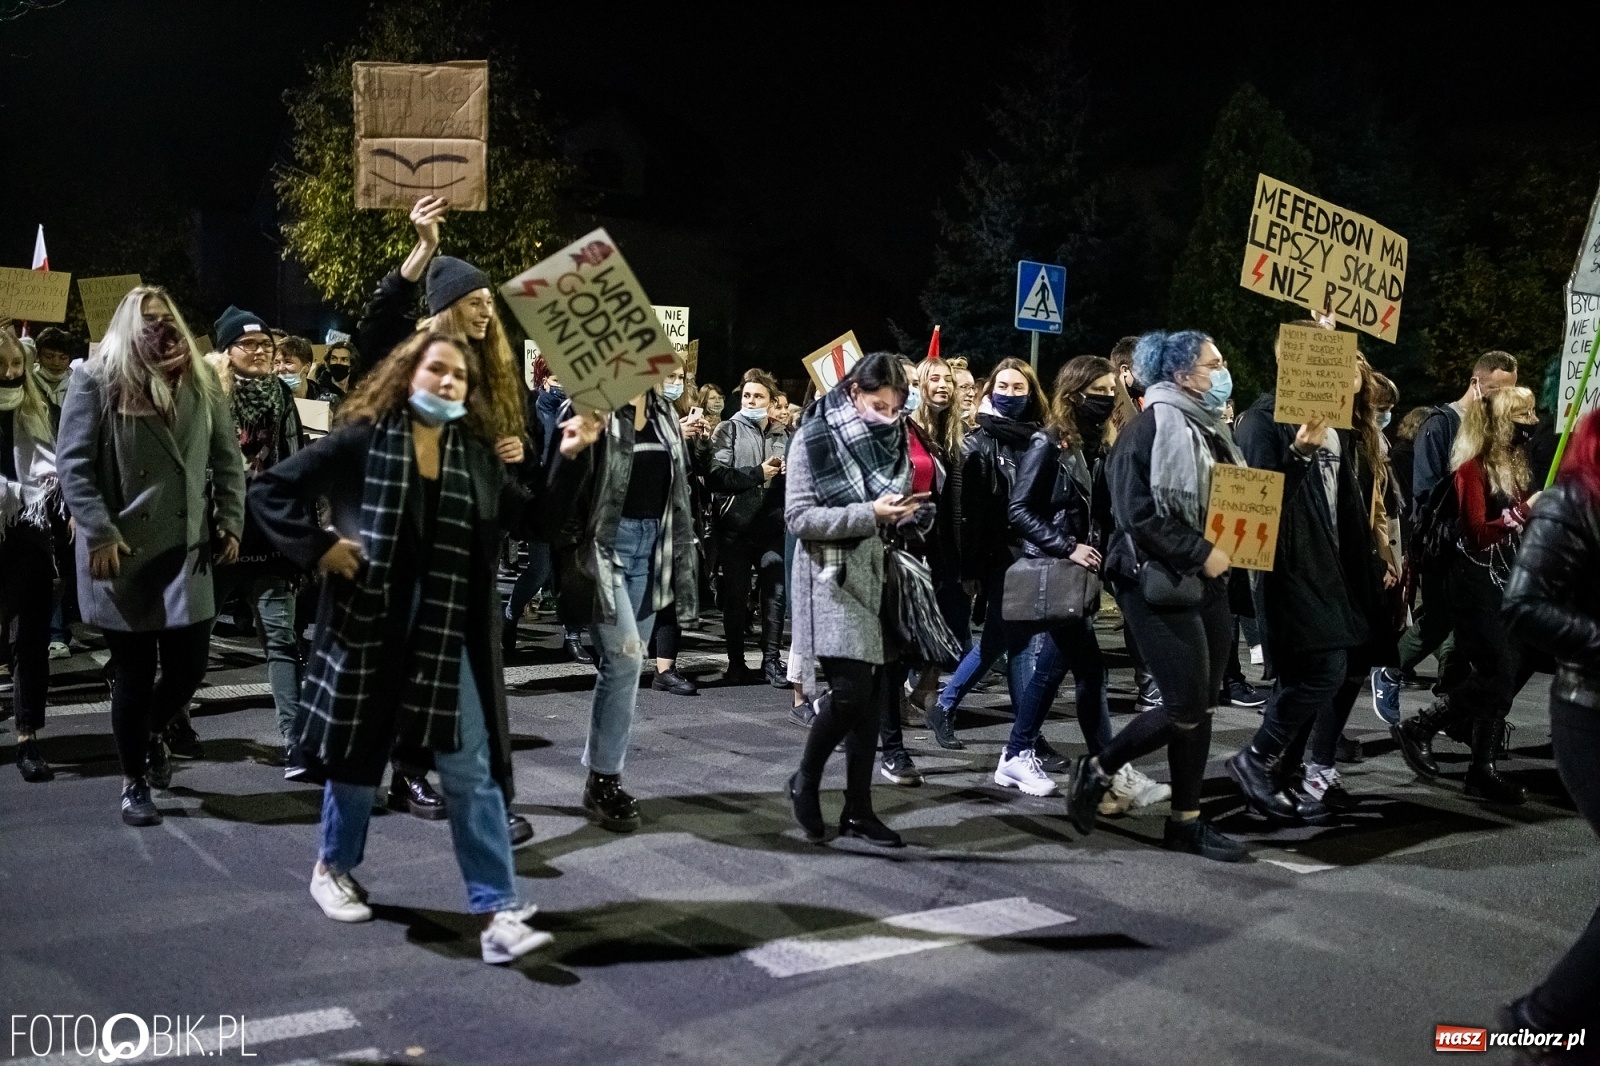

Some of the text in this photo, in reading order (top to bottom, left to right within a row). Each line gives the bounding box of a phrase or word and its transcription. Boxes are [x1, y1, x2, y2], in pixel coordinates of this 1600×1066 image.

[1249, 213, 1404, 302] LEPSZY SKŁAD
[1257, 179, 1404, 272] MEFEDRON MA
[555, 271, 637, 380] GODEK
[591, 266, 658, 353] WARA
[664, 309, 682, 321] NIE
[1269, 261, 1379, 327] NIŻ RZĄD
[526, 348, 537, 360] PIS
[536, 299, 600, 381] MNIE
[1569, 318, 1590, 337] NIE
[1567, 360, 1600, 380] DEY
[1214, 484, 1222, 493] Z
